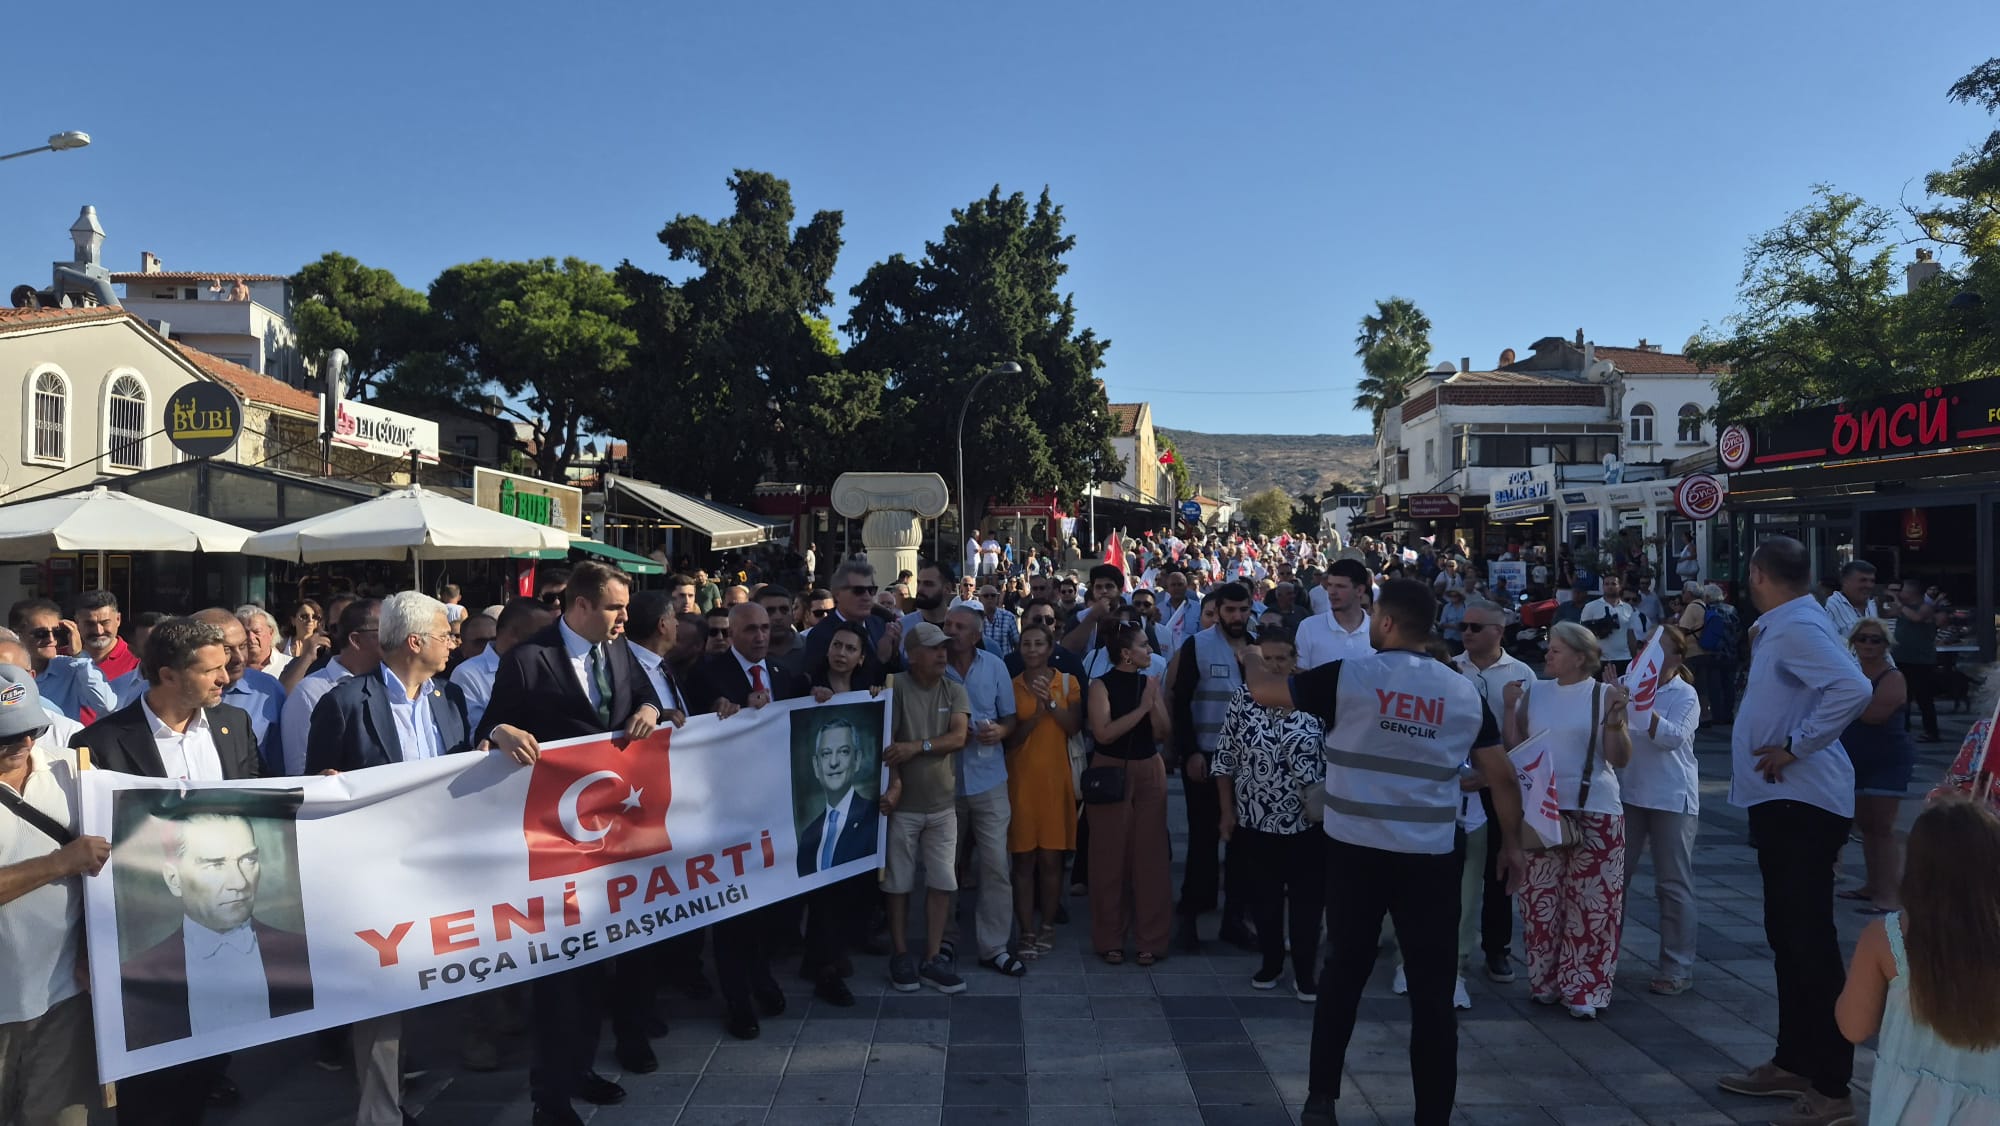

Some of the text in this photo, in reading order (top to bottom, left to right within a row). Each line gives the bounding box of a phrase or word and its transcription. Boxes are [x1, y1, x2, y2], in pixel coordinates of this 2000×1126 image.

[1495, 486, 1526, 503] BALIK
[1375, 688, 1445, 725] YENİ
[354, 829, 775, 968] YENİ PARTİ
[417, 883, 750, 991] FOÇA İLÇE BAŞKANLIĞI
